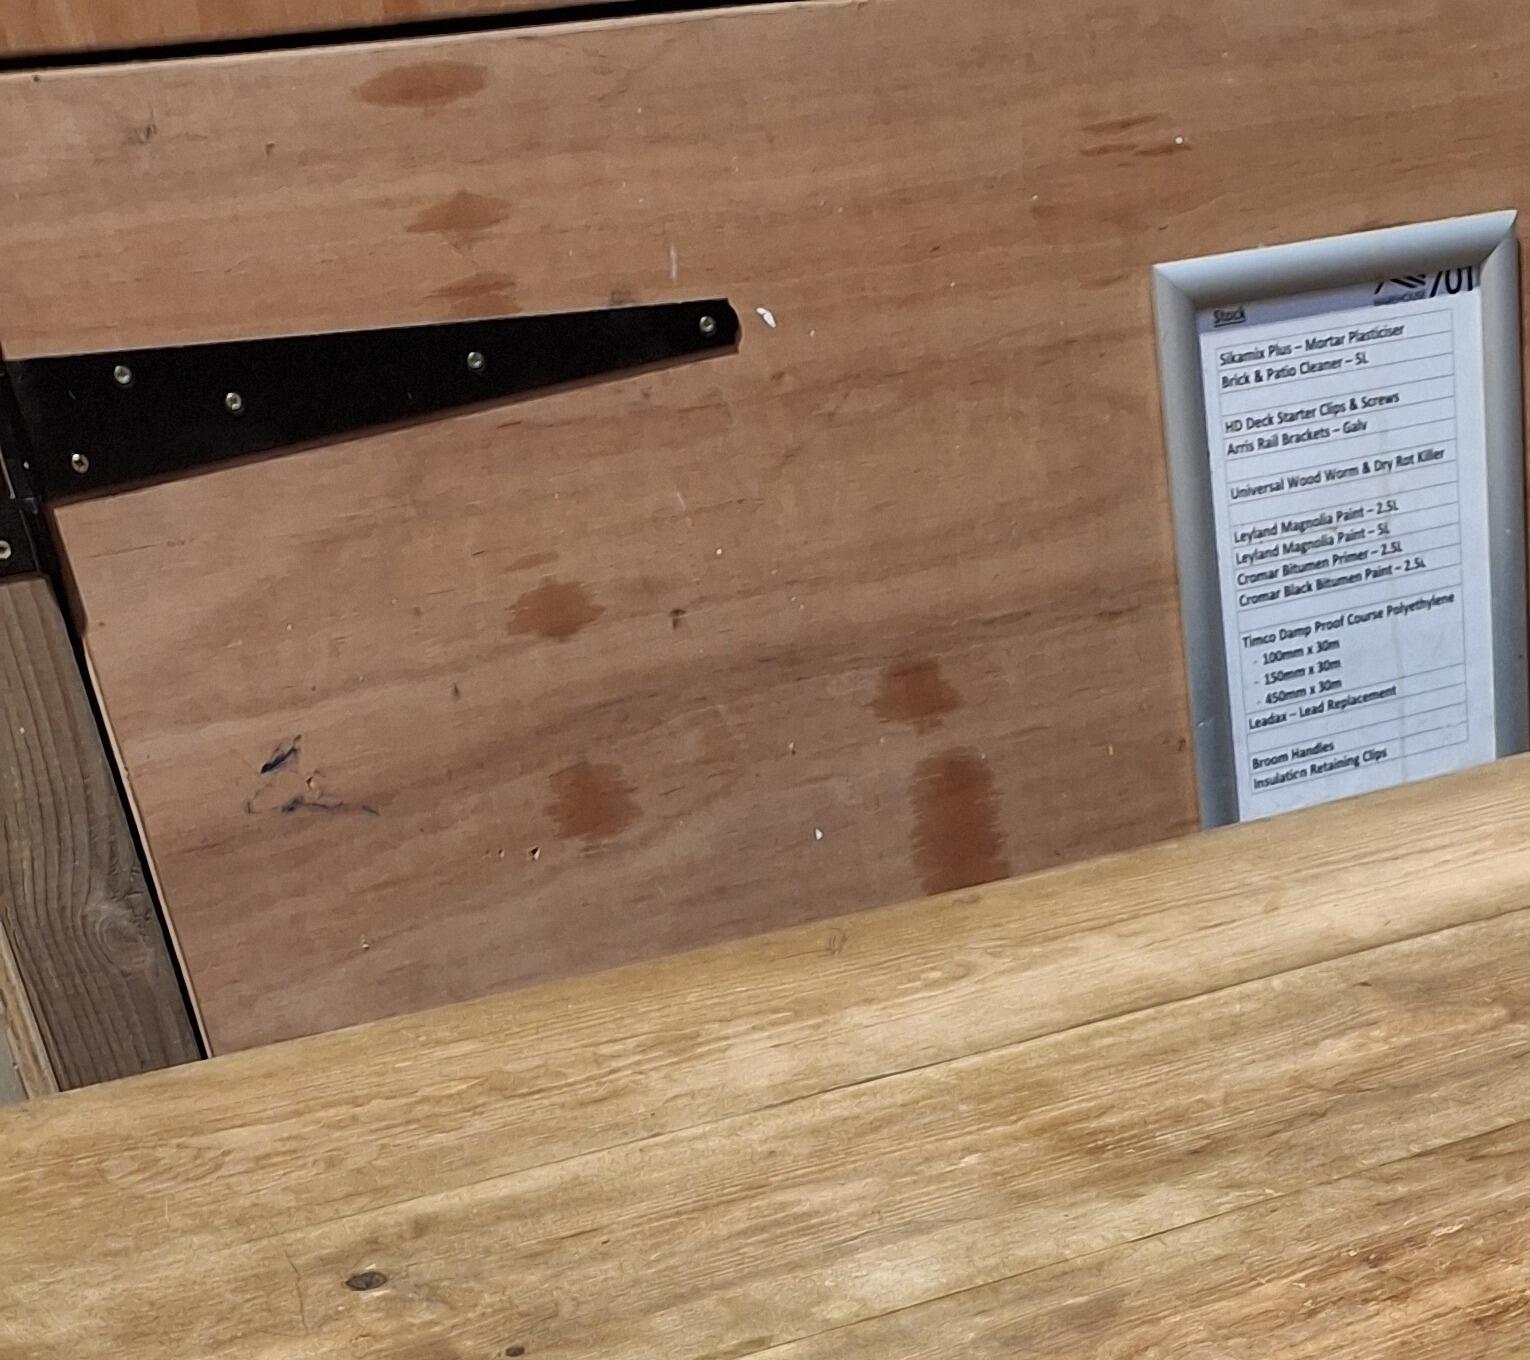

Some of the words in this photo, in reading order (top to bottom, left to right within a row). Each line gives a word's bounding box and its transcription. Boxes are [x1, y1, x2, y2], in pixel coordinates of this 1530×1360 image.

[1220, 345, 1265, 366] Sikamix
[1268, 341, 1292, 358] Plus
[1305, 335, 1345, 352] Mortar
[1348, 324, 1405, 344] Plasticiser
[1222, 373, 1250, 388] Brick
[1254, 369, 1263, 382] &
[1267, 363, 1296, 381] Patio
[1300, 356, 1343, 375] Cleaner
[1355, 353, 1368, 365] 5L
[1225, 420, 1243, 432] HD
[1246, 413, 1274, 429] Deck
[1277, 407, 1316, 424] Starter
[1319, 402, 1346, 416] Clips
[1349, 396, 1358, 409] &
[1361, 392, 1399, 409] Screws
[1227, 441, 1254, 455] Arris
[1257, 434, 1279, 449] Rail
[1282, 426, 1331, 445] Brackets
[1343, 420, 1368, 433] Galv
[1230, 479, 1284, 499] Universal
[1287, 472, 1321, 488] Wood
[1325, 467, 1358, 481] Worm
[1362, 461, 1370, 474] &
[1374, 457, 1393, 473] Dry
[1396, 453, 1414, 466] Rot
[1417, 448, 1446, 462] Killer
[1234, 525, 1277, 544] Leyland
[1281, 512, 1333, 535] Magnolia
[1336, 506, 1364, 522] Paint
[1376, 500, 1399, 514] 2.5L
[1236, 546, 1280, 565] Leyland
[1282, 534, 1334, 555] Magnolia
[1337, 528, 1366, 544] Paint
[1377, 522, 1390, 536] 5L
[1237, 569, 1279, 585] Cromar
[1282, 558, 1329, 576] Bitumen
[1332, 549, 1368, 566] Primer
[1381, 541, 1402, 556] 2.5L
[1239, 589, 1281, 606] Cromar
[1284, 581, 1313, 597] Black
[1316, 571, 1363, 589] Bitumen
[1365, 565, 1393, 582] Paint
[1404, 557, 1426, 571] 2.5L
[1242, 632, 1276, 649] Timco
[1279, 624, 1312, 642] Damp
[1314, 615, 1344, 633] Proof
[1347, 607, 1383, 625] Course
[1386, 592, 1454, 617] Polyethylene
[1262, 649, 1304, 665] 100mm
[1307, 647, 1313, 655] x
[1316, 639, 1340, 653] 30m
[1264, 669, 1305, 685] 150mm
[1308, 667, 1315, 675] x
[1318, 658, 1341, 673] 30m
[1265, 688, 1307, 705] 450mm
[1309, 686, 1316, 695] x
[1319, 678, 1342, 692] 30m
[1299, 700, 1324, 717] Lead
[1327, 685, 1397, 712] Replacement
[1253, 753, 1289, 769] Broom
[1292, 741, 1335, 760] Handles
[1254, 767, 1308, 789] Insulation
[1310, 755, 1360, 775] Retaining
[1363, 748, 1388, 764] Clips
